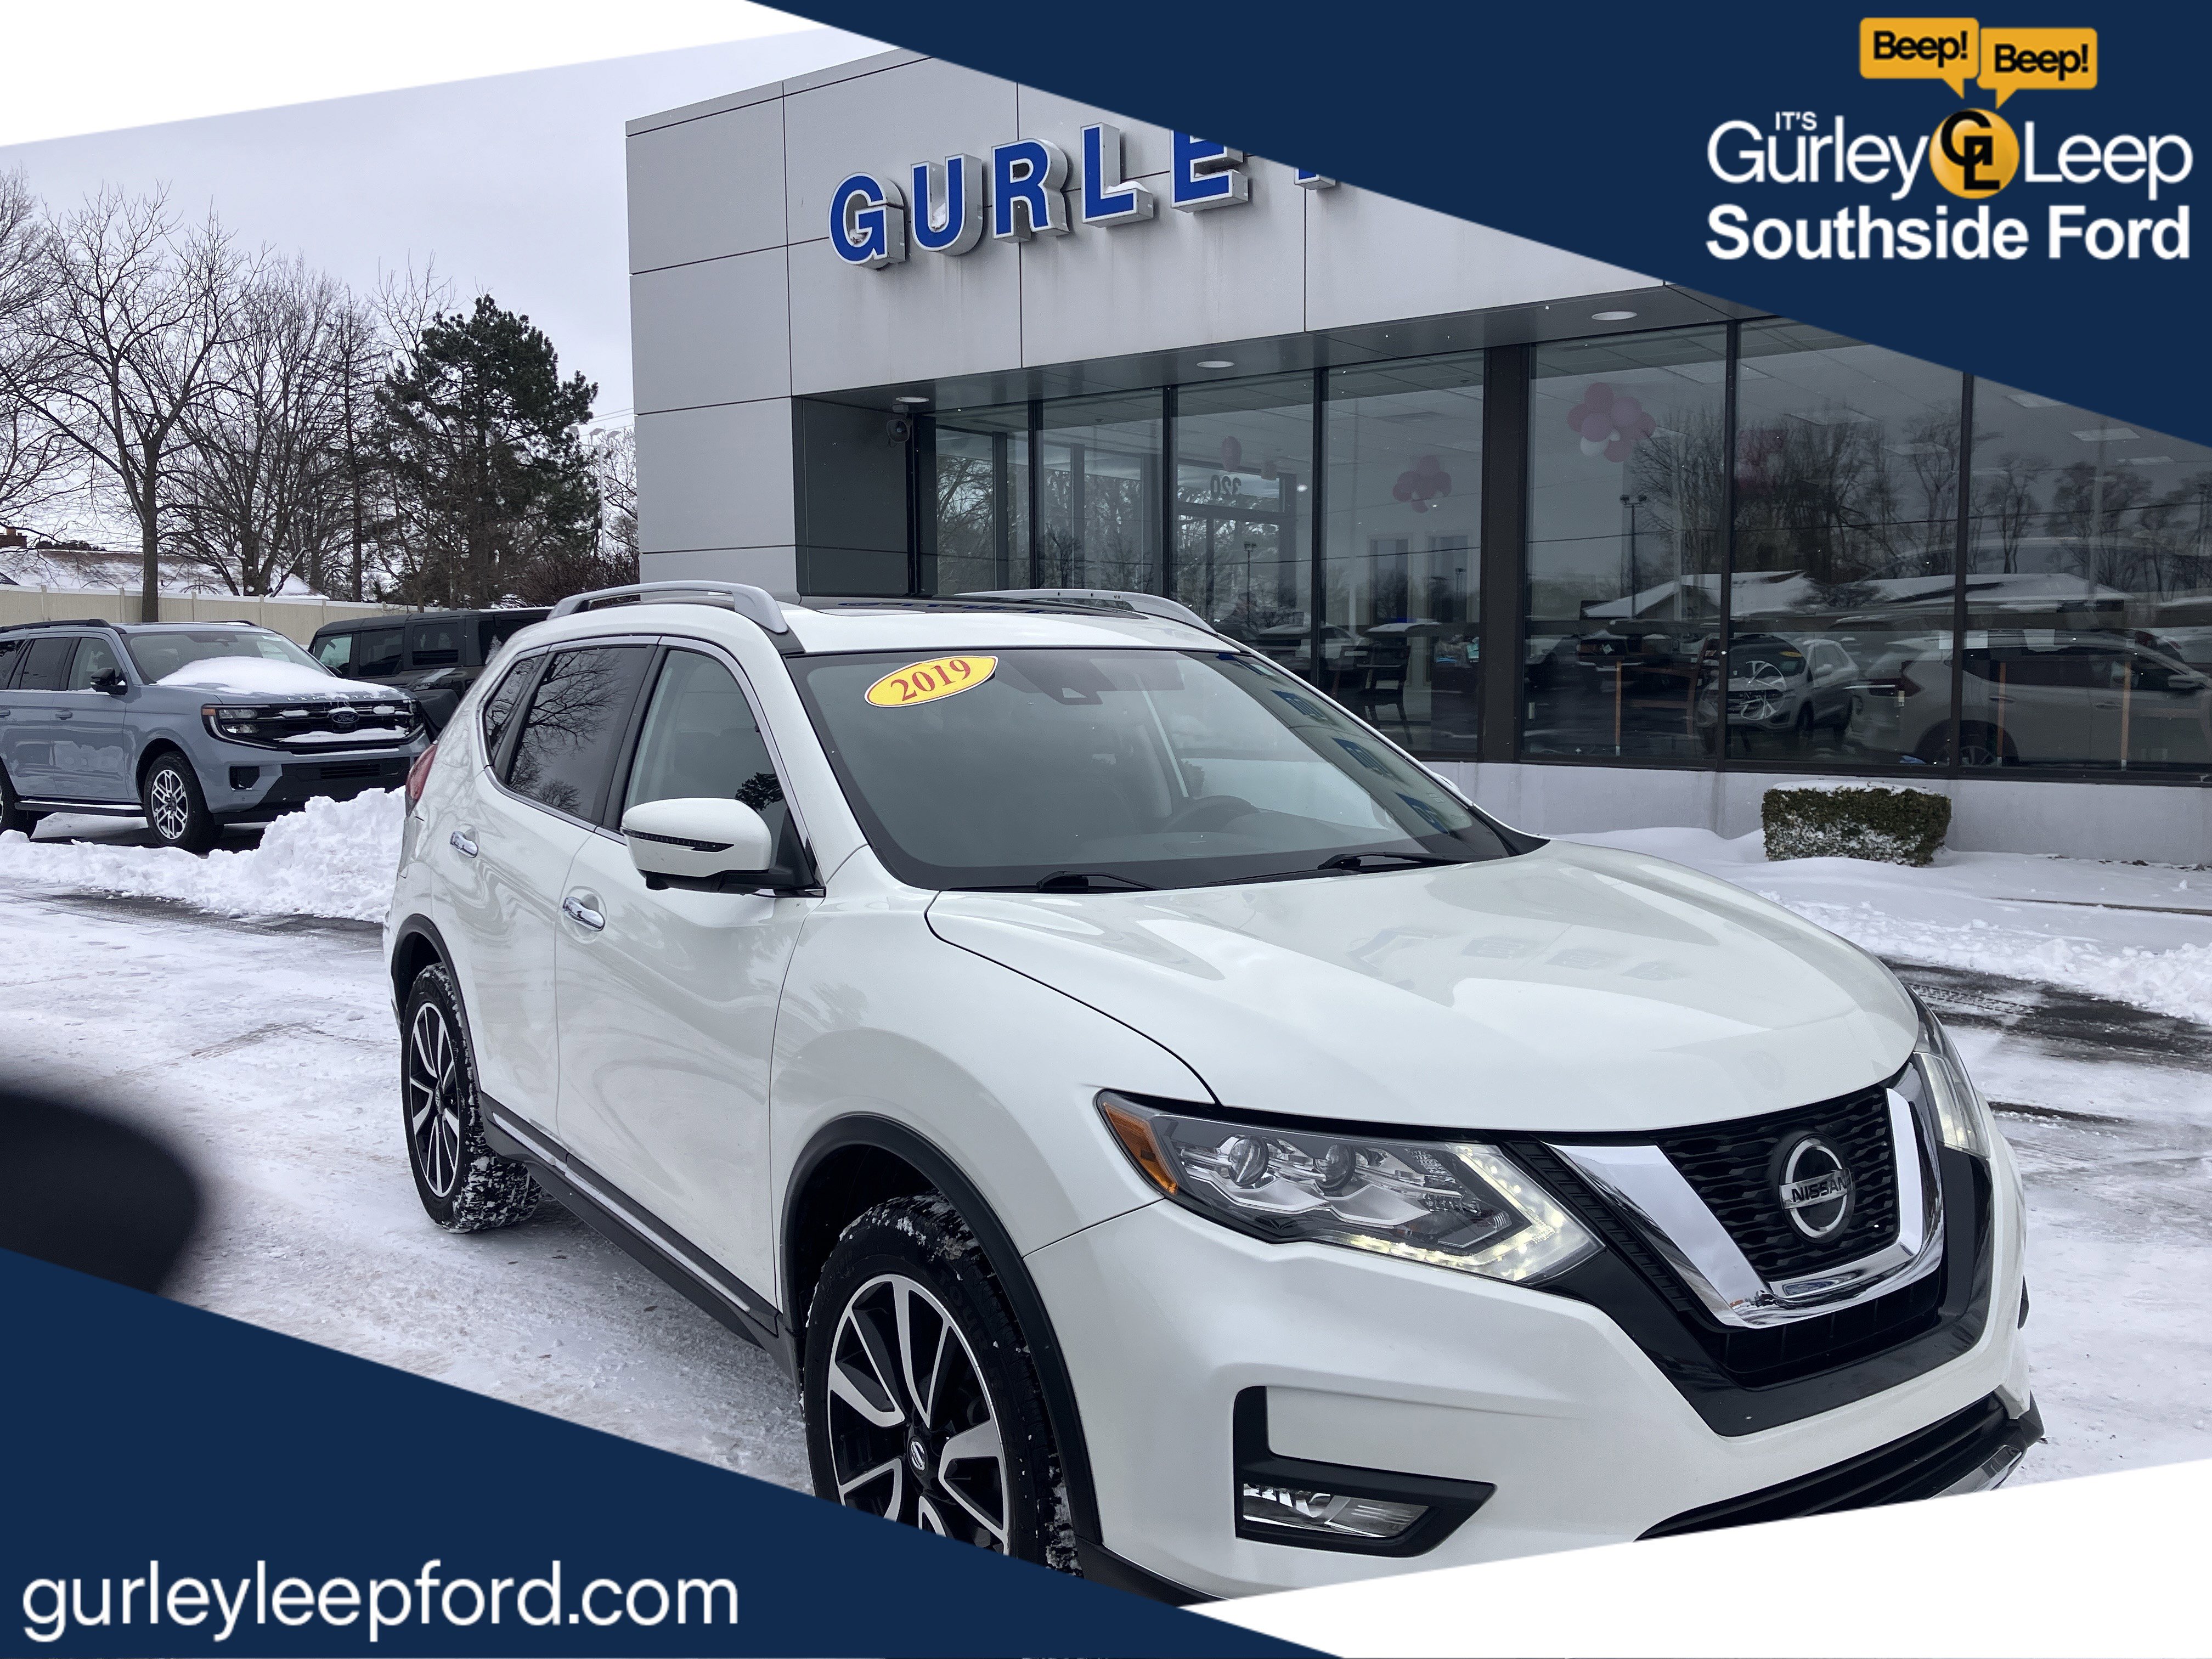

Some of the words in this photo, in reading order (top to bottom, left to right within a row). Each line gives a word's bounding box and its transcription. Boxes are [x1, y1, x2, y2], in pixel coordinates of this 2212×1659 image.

[828, 122, 1336, 269] GURLE
[890, 659, 972, 701] 2019
[1791, 1176, 1852, 1203] NISSAN
